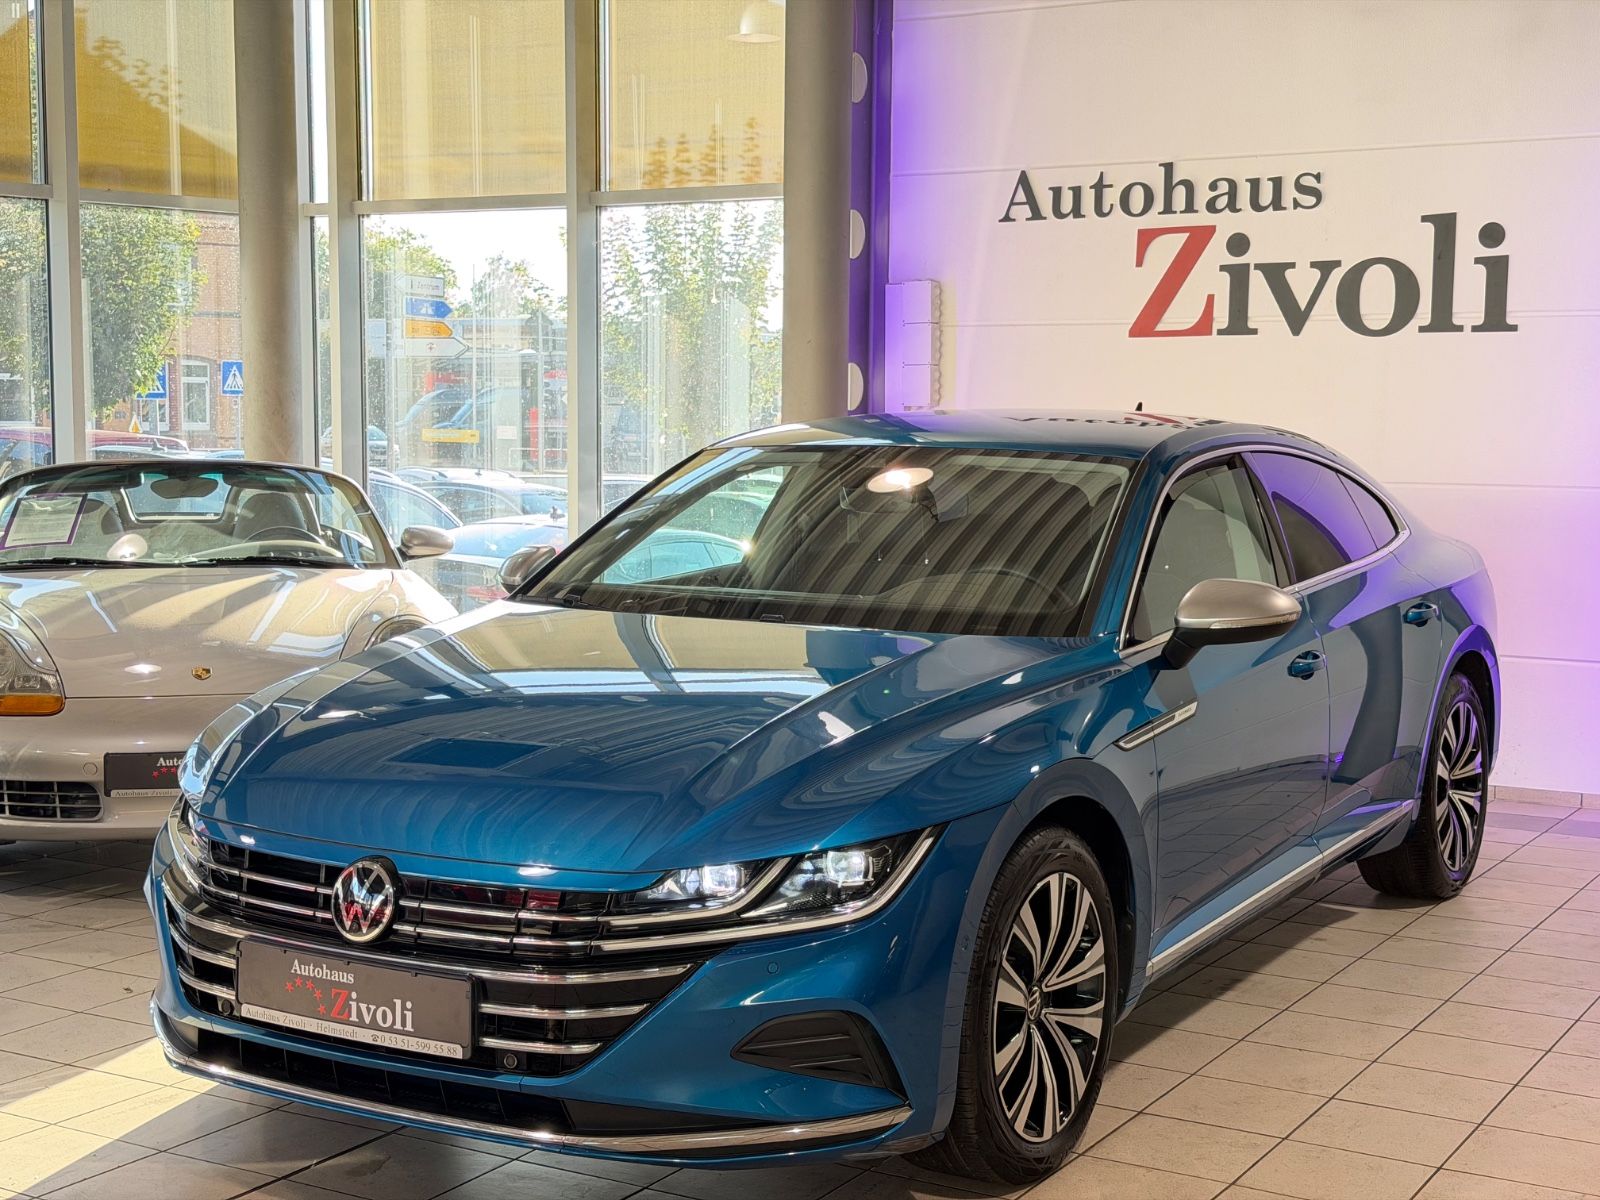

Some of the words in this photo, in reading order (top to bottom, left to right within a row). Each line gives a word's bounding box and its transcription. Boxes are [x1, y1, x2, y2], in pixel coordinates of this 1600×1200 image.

[998, 161, 1324, 223] Autohaus
[1128, 211, 1519, 338] Zivoli
[291, 959, 355, 984] Autohaus
[245, 1007, 280, 1022] Autohaus
[282, 1015, 306, 1029] Zivoli
[316, 1022, 358, 1039] Helmstedt
[330, 988, 415, 1032] Zivoli
